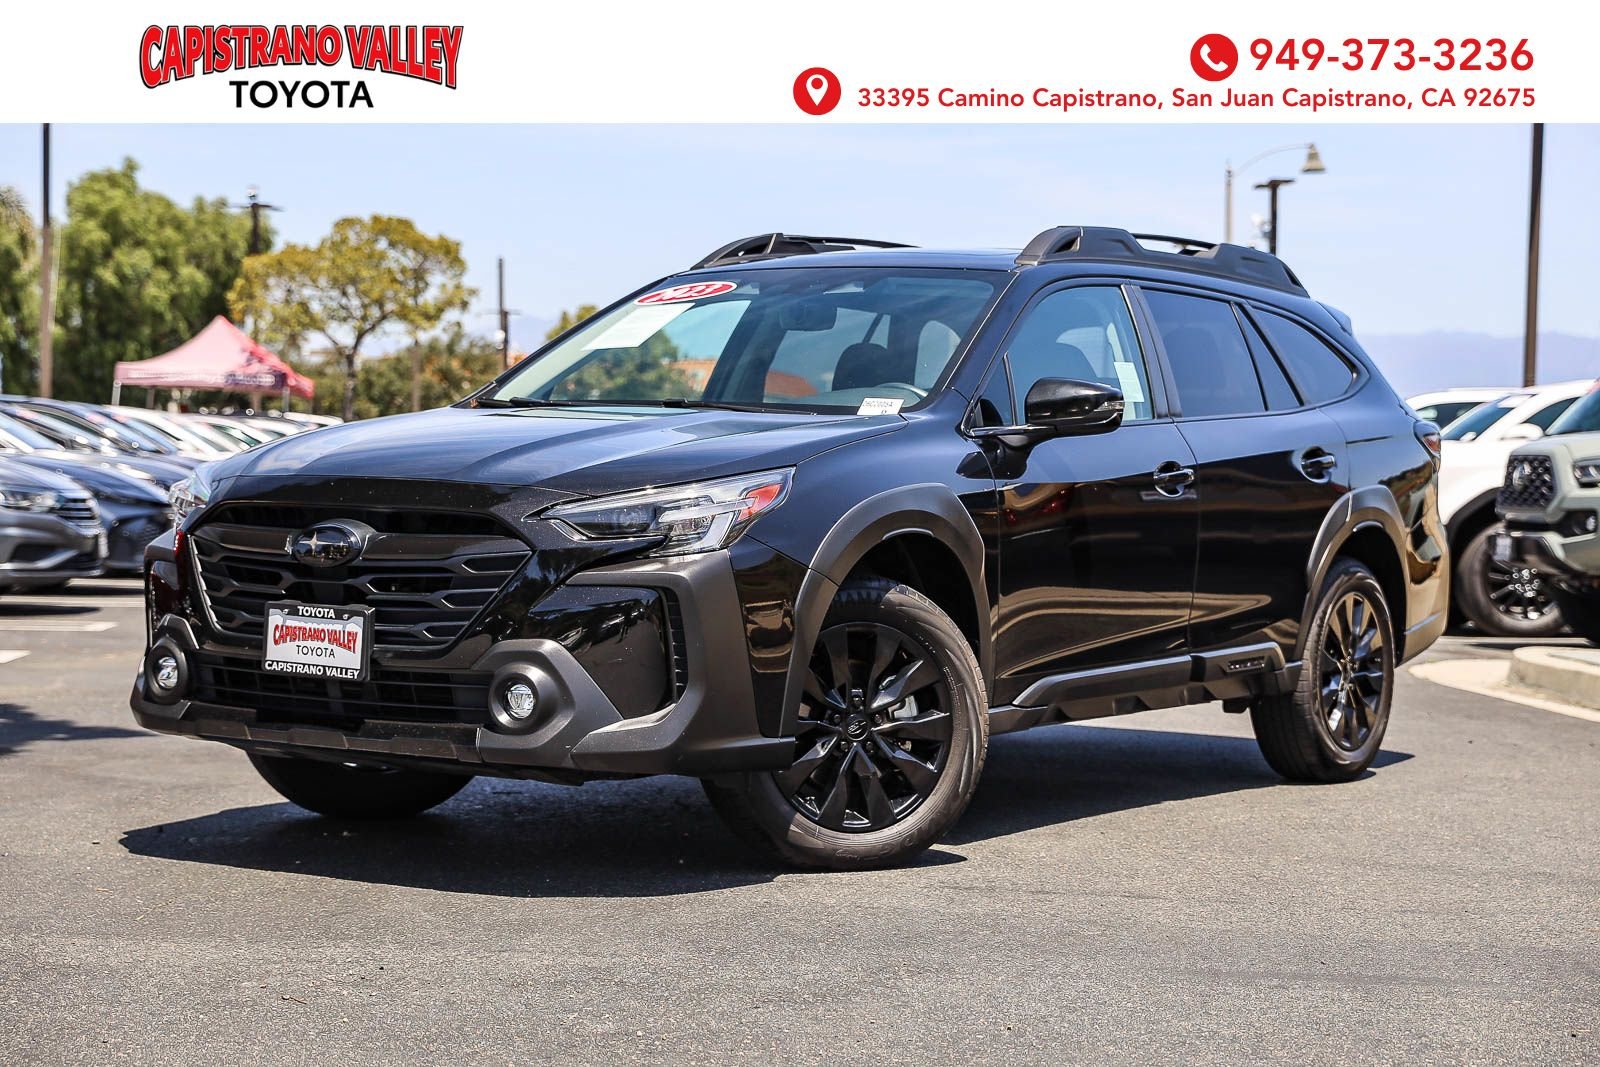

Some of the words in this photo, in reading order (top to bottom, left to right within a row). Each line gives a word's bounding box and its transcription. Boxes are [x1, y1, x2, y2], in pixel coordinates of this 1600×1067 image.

[297, 606, 336, 618] TOYOTA
[273, 624, 326, 645] CAPISTRANO
[327, 629, 358, 654] VALLEY
[296, 645, 336, 659] TOYOTA
[265, 660, 323, 675] CAPISTRANO
[326, 667, 360, 680] VALLEY
